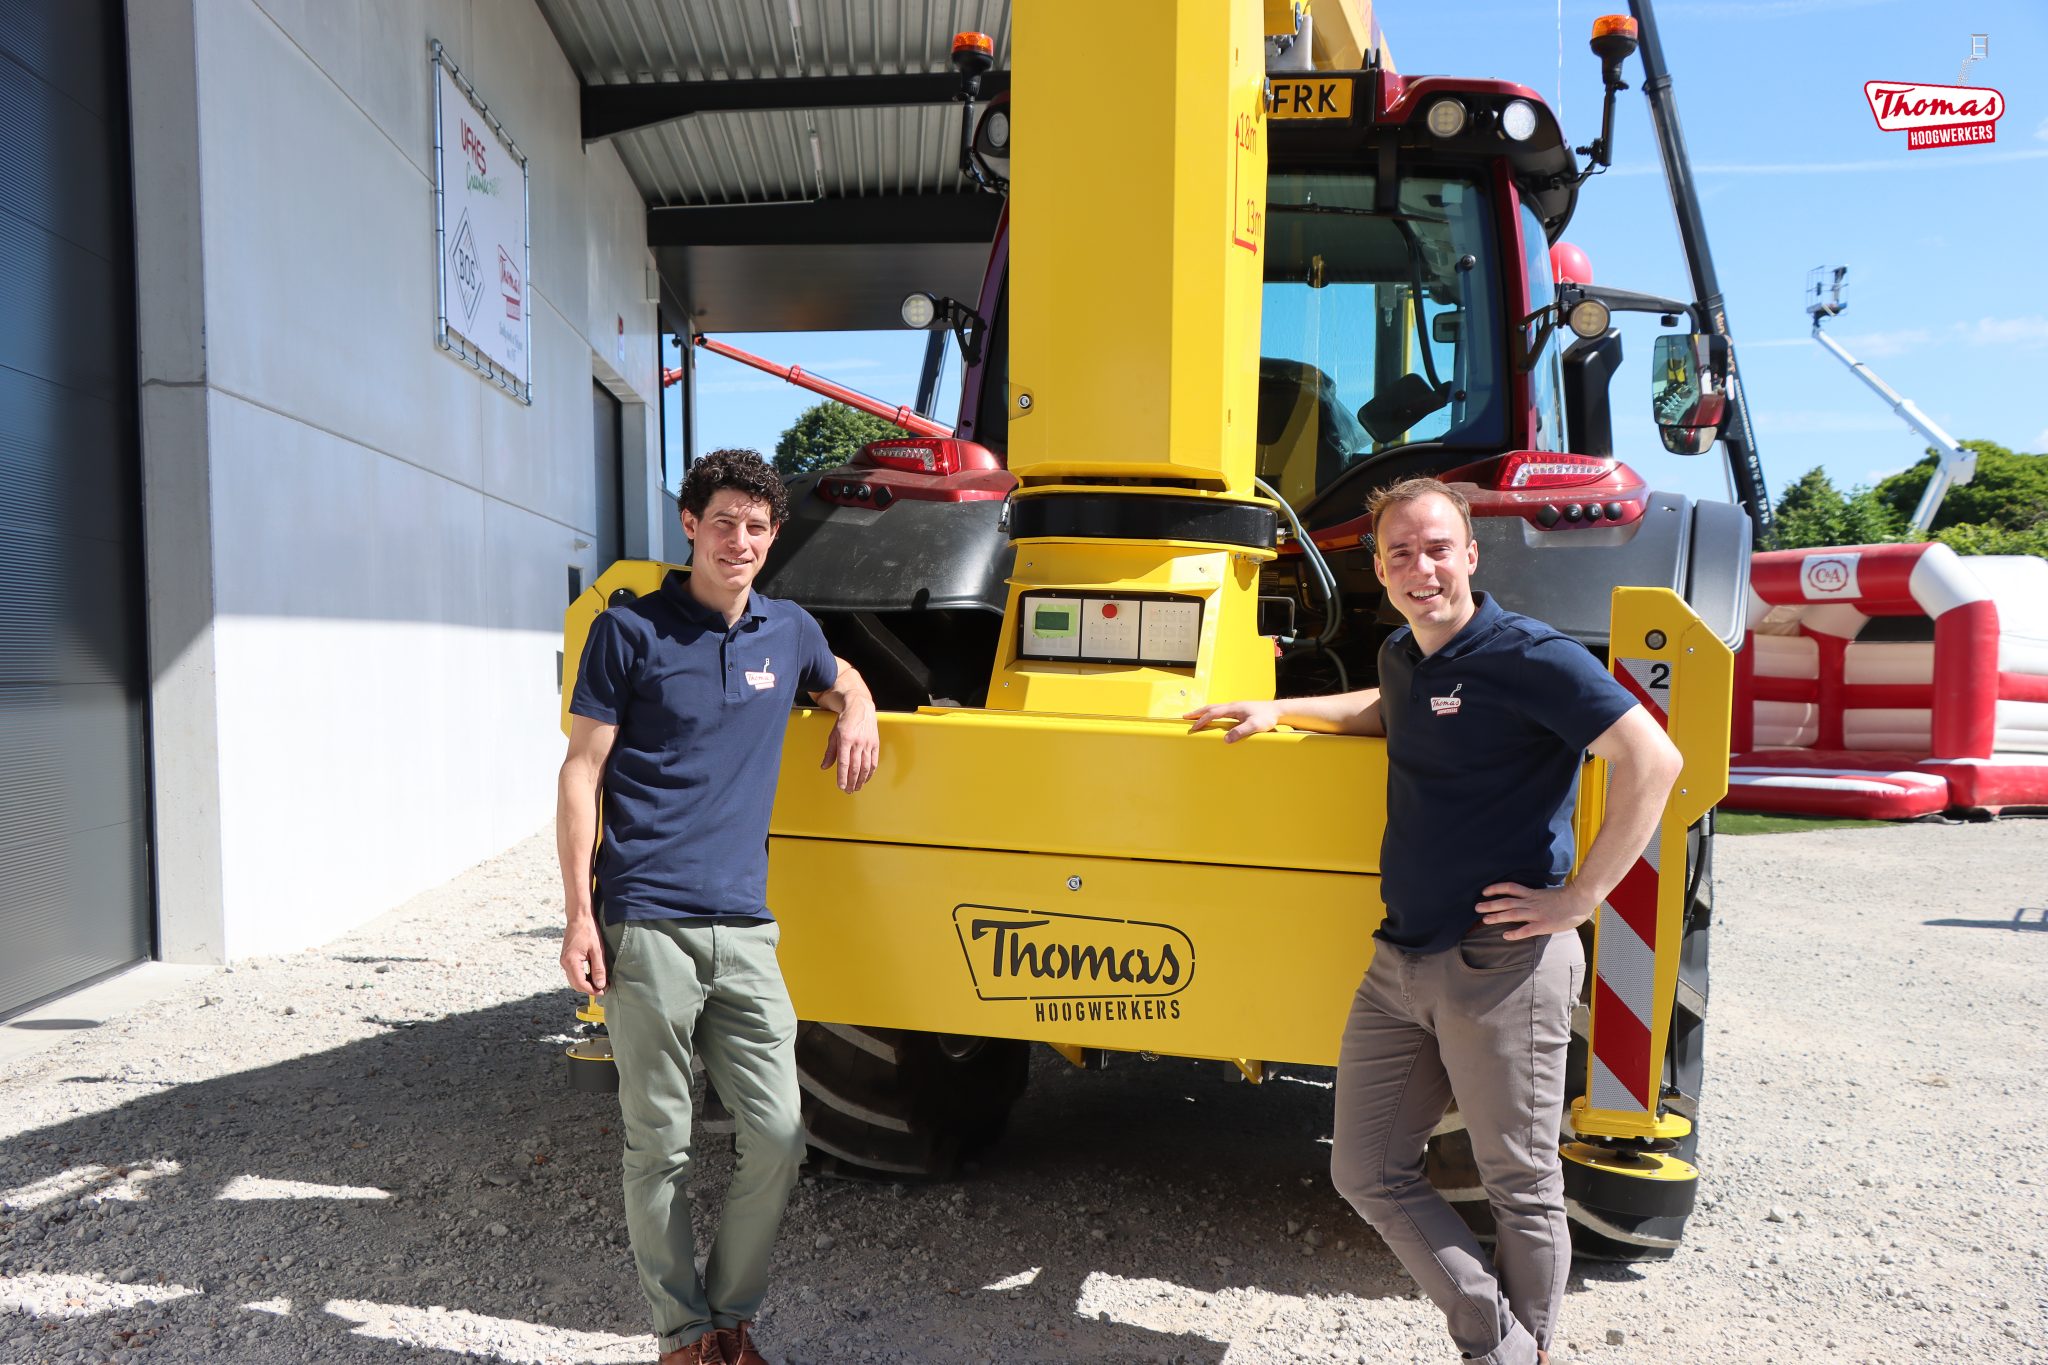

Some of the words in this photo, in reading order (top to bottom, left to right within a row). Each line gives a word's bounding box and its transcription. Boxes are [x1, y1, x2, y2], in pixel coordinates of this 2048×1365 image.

[1239, 111, 1257, 156] 18m
[1246, 198, 1262, 239] 13m
[459, 247, 476, 291] BOS
[1815, 568, 1841, 584] C&A
[1649, 663, 1670, 689] 2
[1432, 699, 1460, 708] Thomas
[972, 919, 1180, 985] Thomas
[1035, 1000, 1181, 1022] HOOGWERKERS
